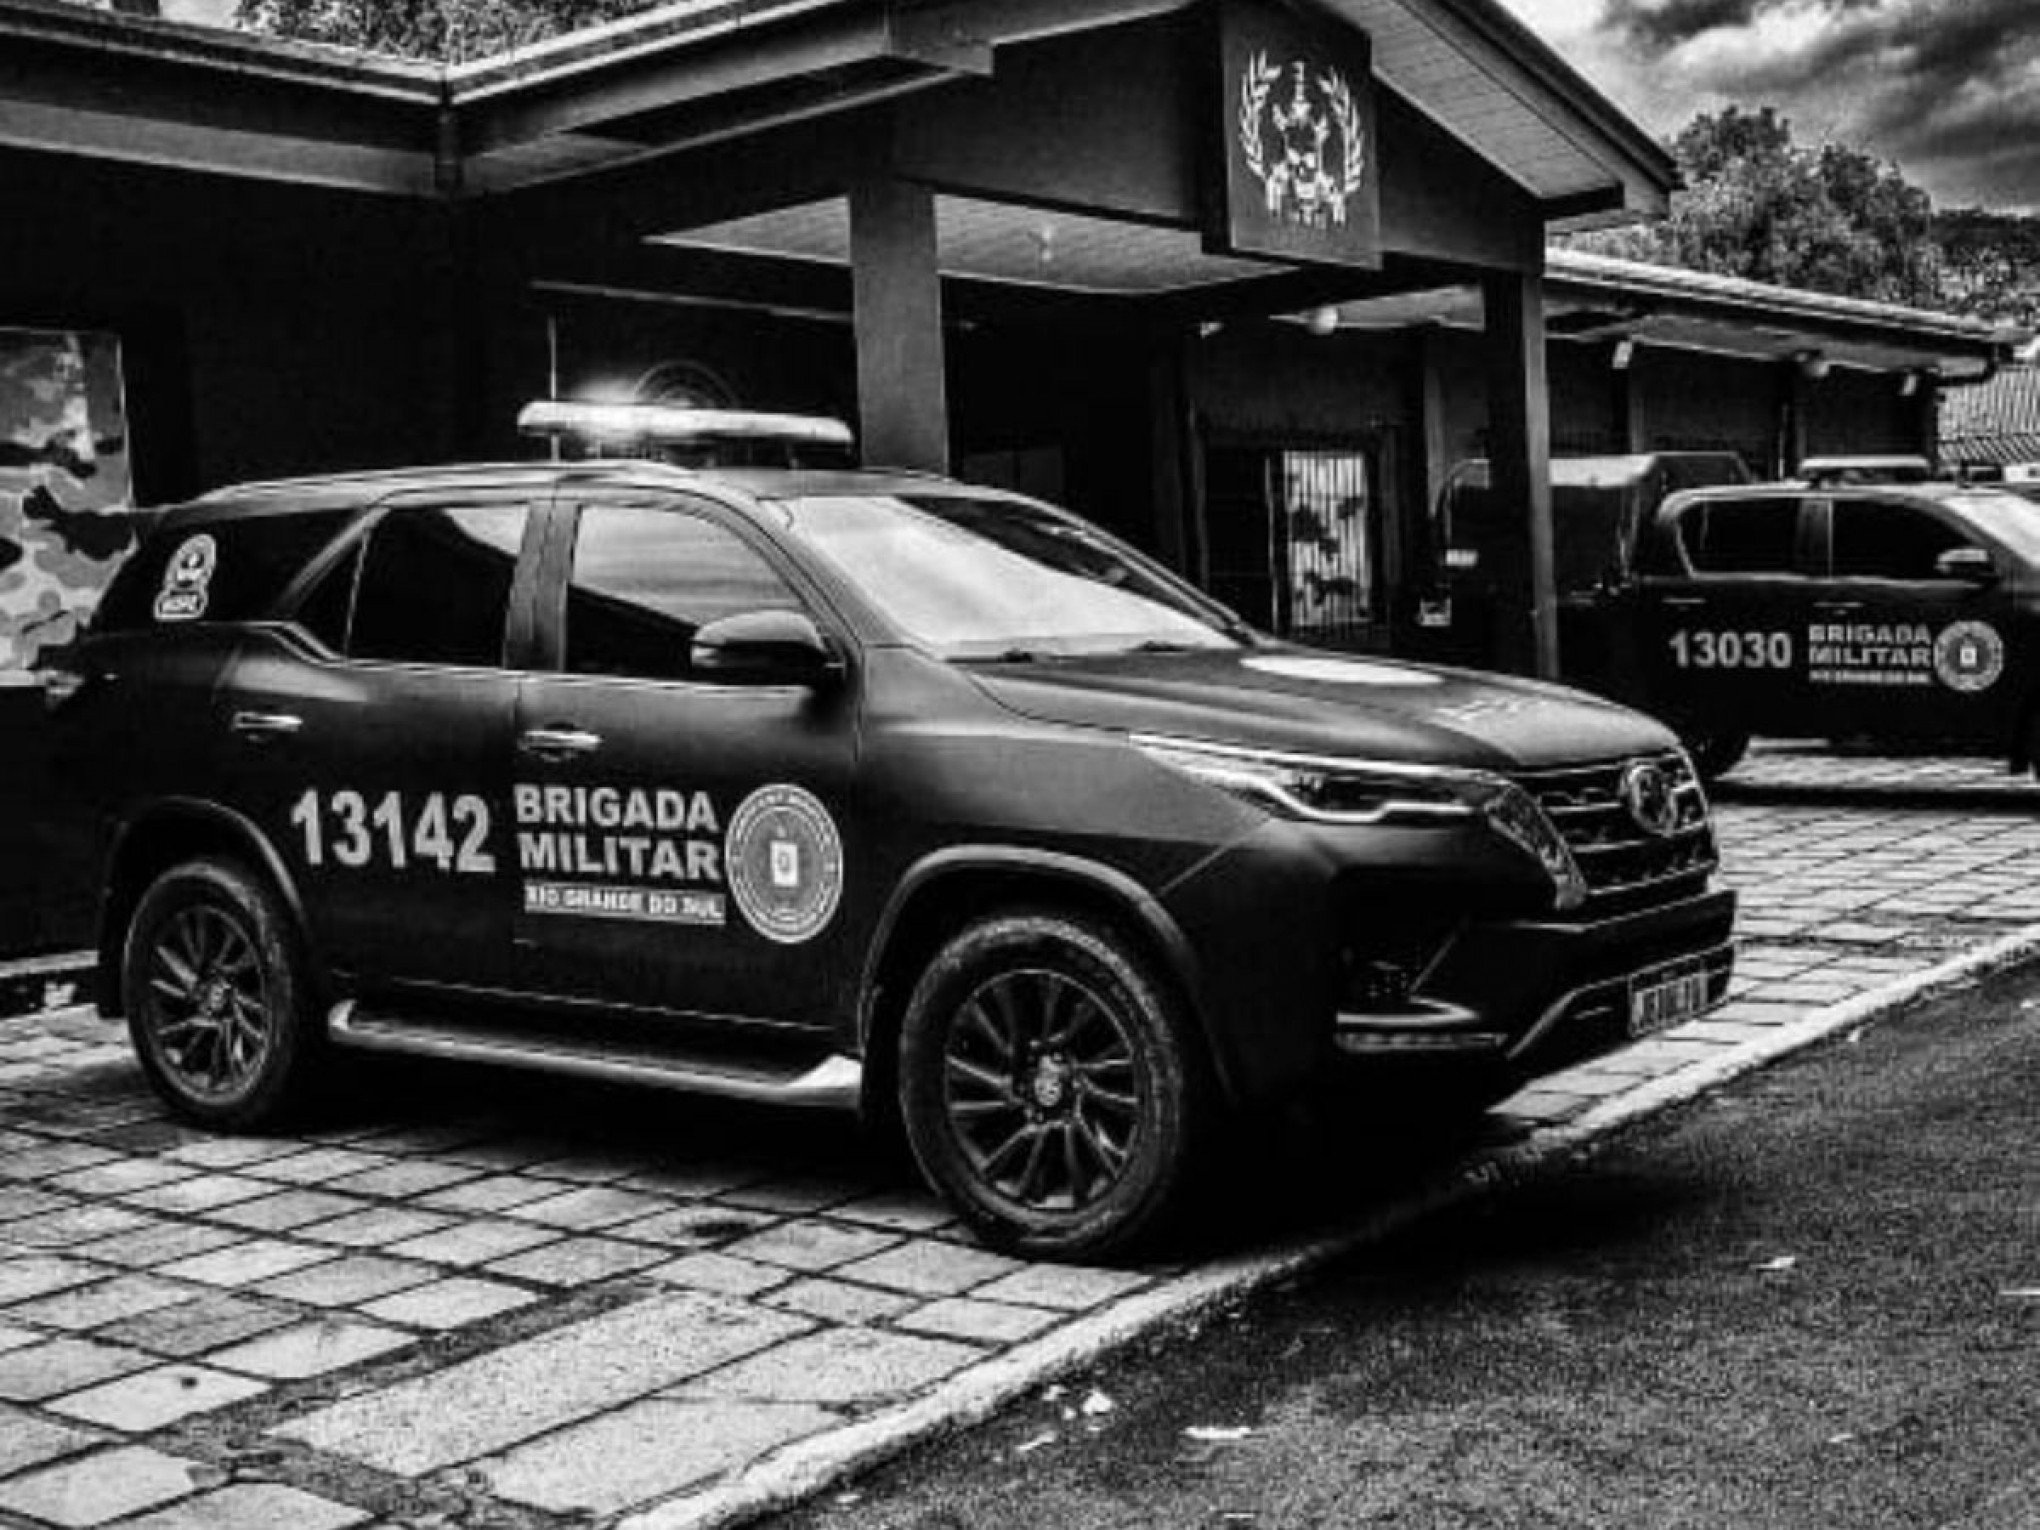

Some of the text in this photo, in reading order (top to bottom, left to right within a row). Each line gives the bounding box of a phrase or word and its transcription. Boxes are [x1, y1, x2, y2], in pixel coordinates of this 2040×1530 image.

[1669, 631, 1792, 668] 13030
[1809, 624, 1931, 644] BRIGADA
[1809, 645, 1931, 667] MILITAR
[514, 784, 719, 832] BRIGADA
[291, 789, 496, 873] 13142
[517, 832, 721, 880] MILITAR
